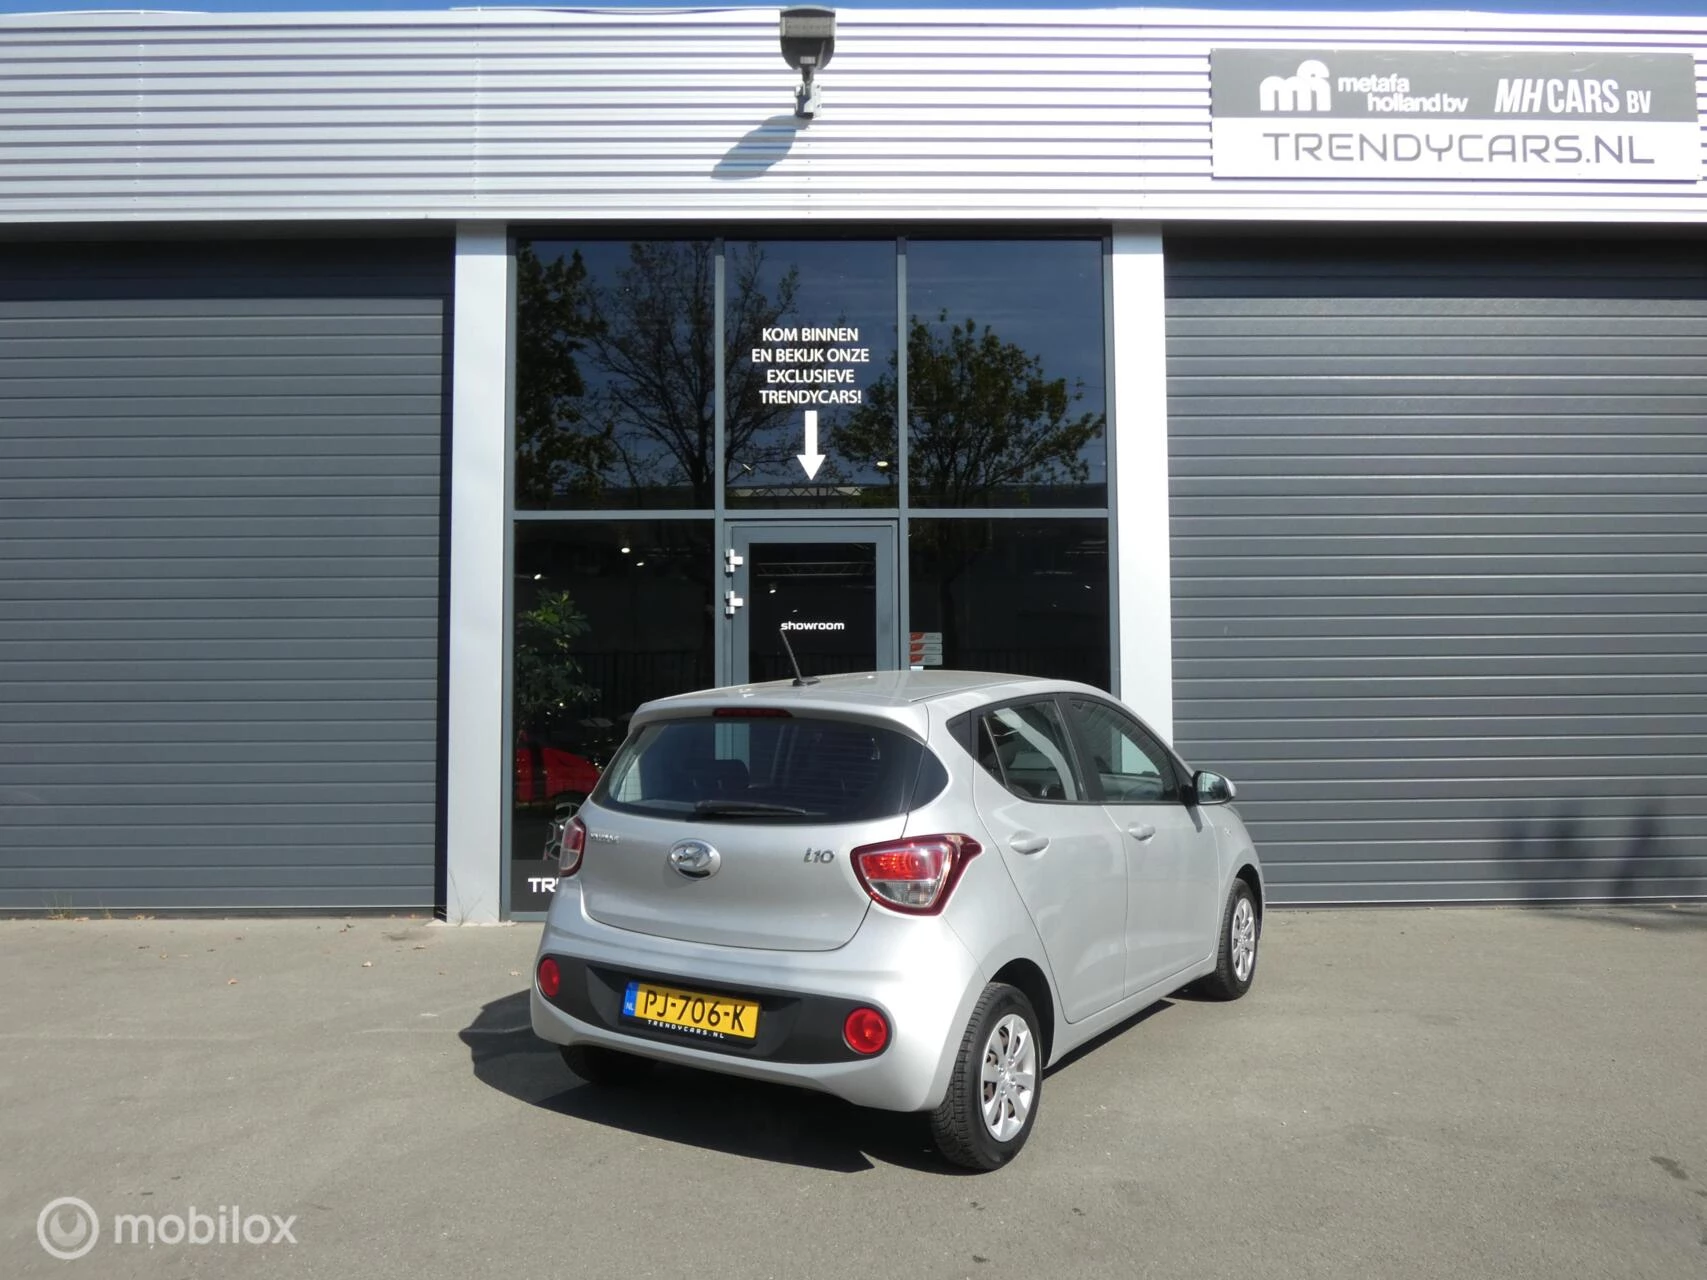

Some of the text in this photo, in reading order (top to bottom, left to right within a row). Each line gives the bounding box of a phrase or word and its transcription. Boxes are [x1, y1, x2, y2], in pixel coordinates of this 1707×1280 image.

[1337, 73, 1410, 92] metafa
[1626, 90, 1652, 114] BV
[1262, 133, 1656, 164] TRENDYCARS.NL
[762, 328, 859, 341] KOM BINNEN
[751, 348, 870, 362] EN BEKIJK ONZE
[766, 369, 855, 383] EXCLUSIEVE
[759, 390, 862, 404] TRENDYCARS!
[780, 621, 845, 631] showroom
[803, 847, 835, 864] i10
[643, 989, 746, 1032] PJ-706-K
[647, 1019, 725, 1039] TRENDYCARS.NL
